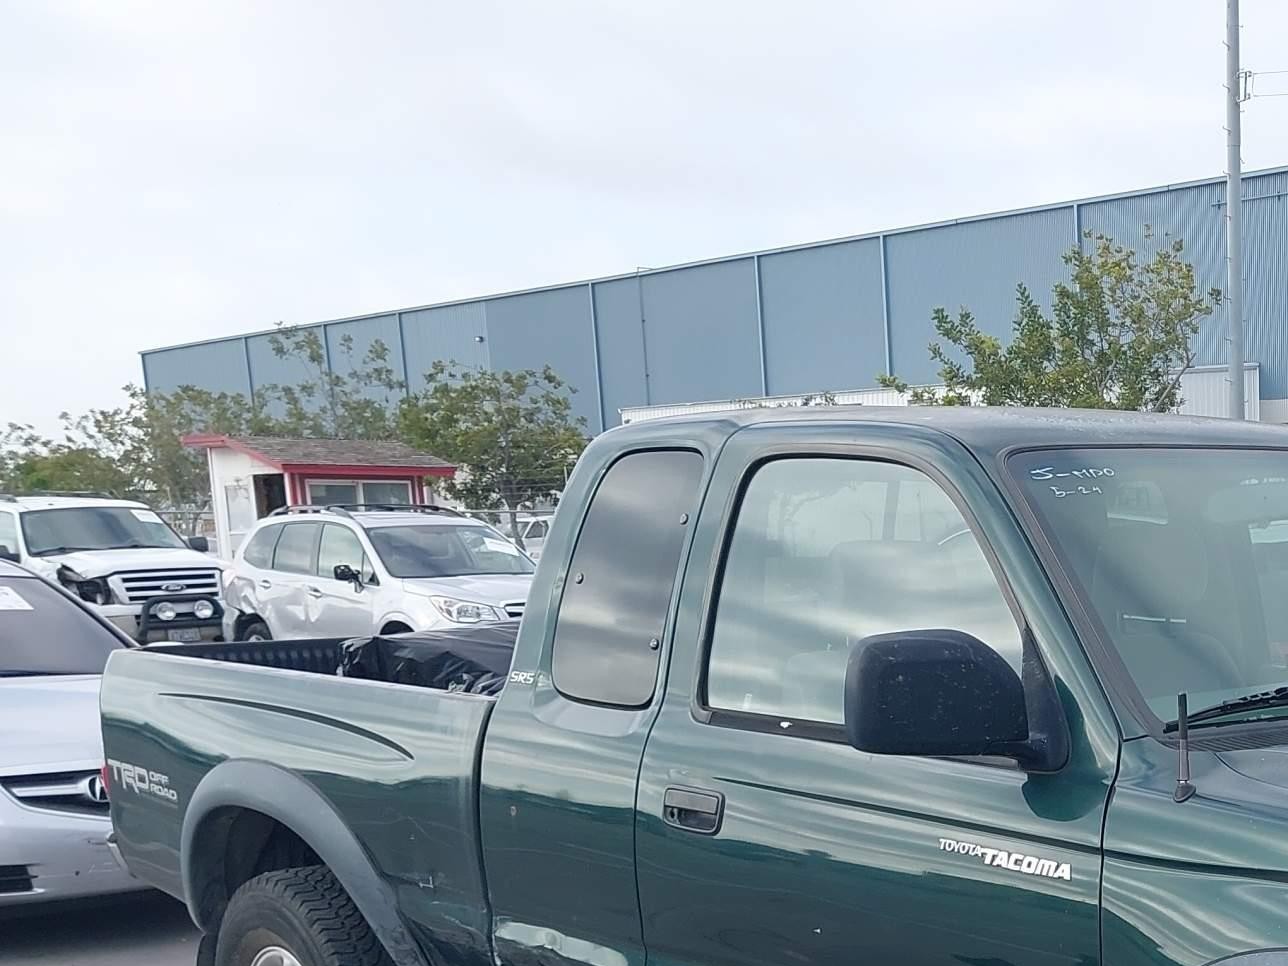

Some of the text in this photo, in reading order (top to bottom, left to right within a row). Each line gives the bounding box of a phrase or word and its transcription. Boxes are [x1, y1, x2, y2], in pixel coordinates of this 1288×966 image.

[510, 670, 535, 684] SR5
[107, 758, 149, 794] TRD
[149, 771, 169, 785] OFF
[150, 783, 178, 801] ROAD
[939, 838, 1072, 881] TOYOTA TACOMA
